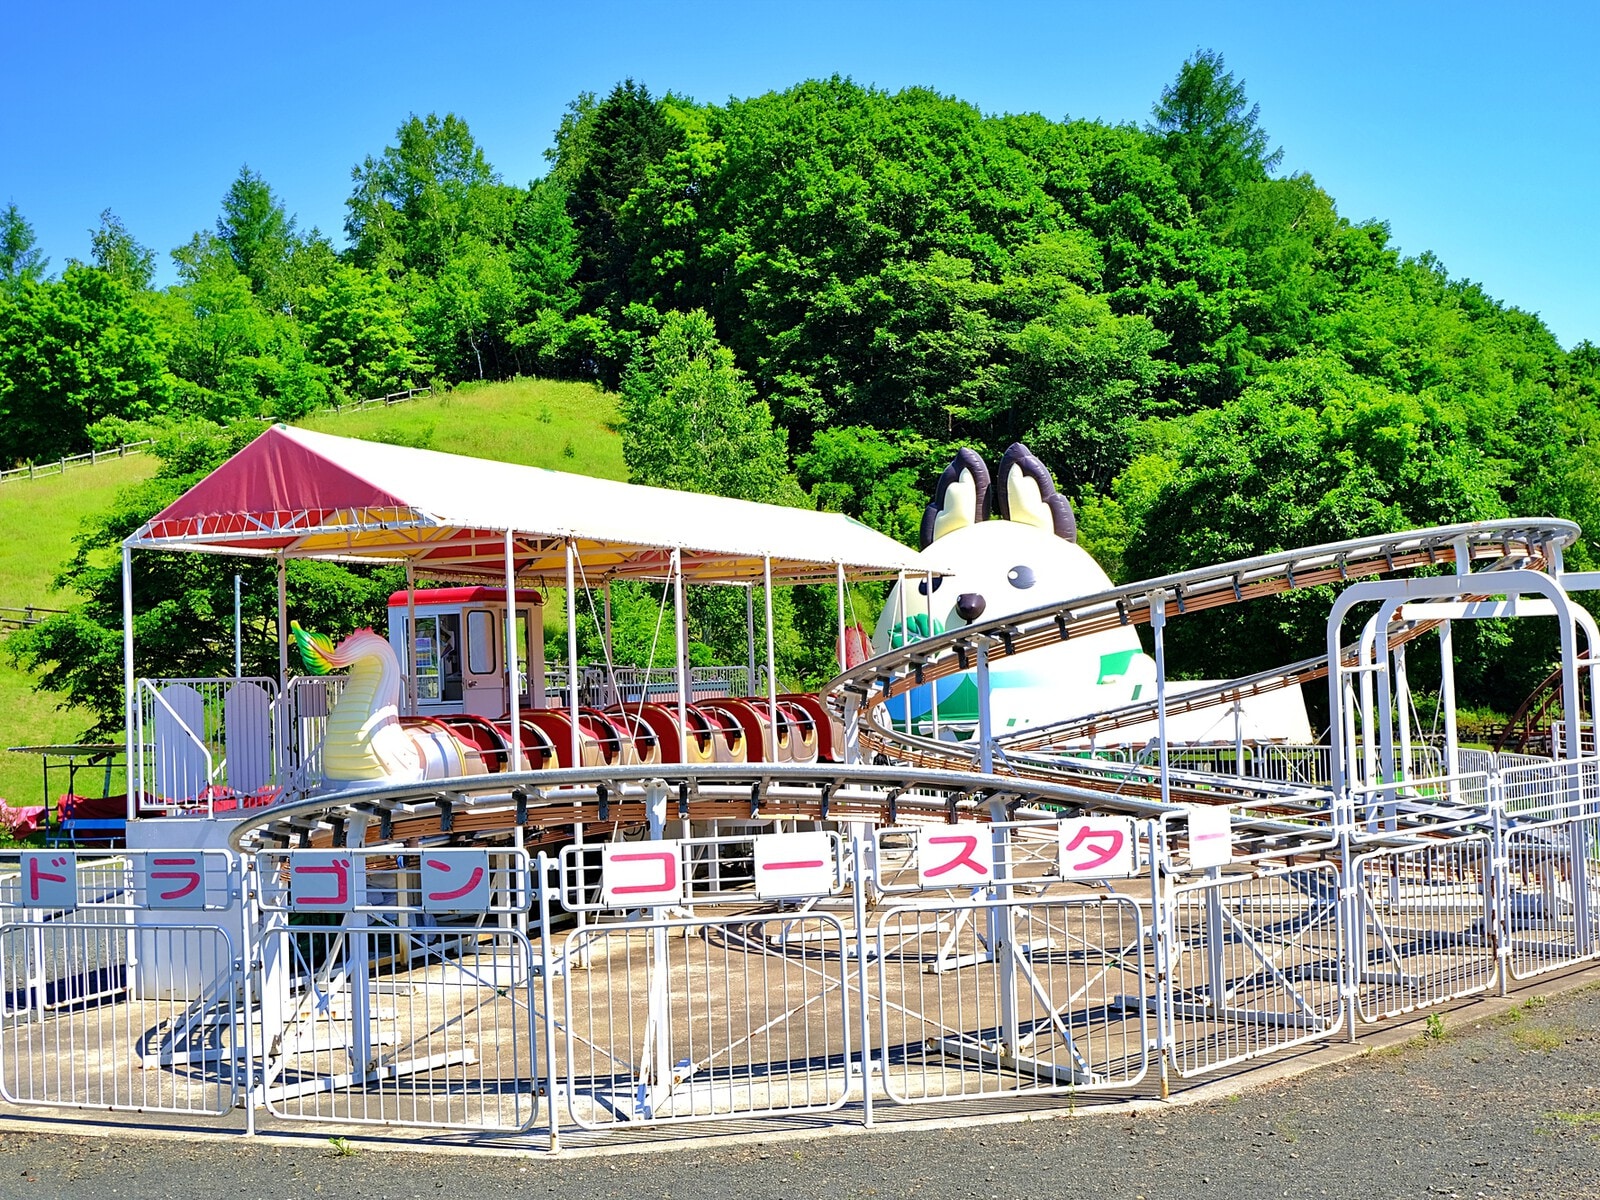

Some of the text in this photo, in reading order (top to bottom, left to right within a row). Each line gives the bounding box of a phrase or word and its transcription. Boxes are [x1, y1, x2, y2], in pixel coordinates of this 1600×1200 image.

[30, 826, 1225, 905] ドラゴンコースター
